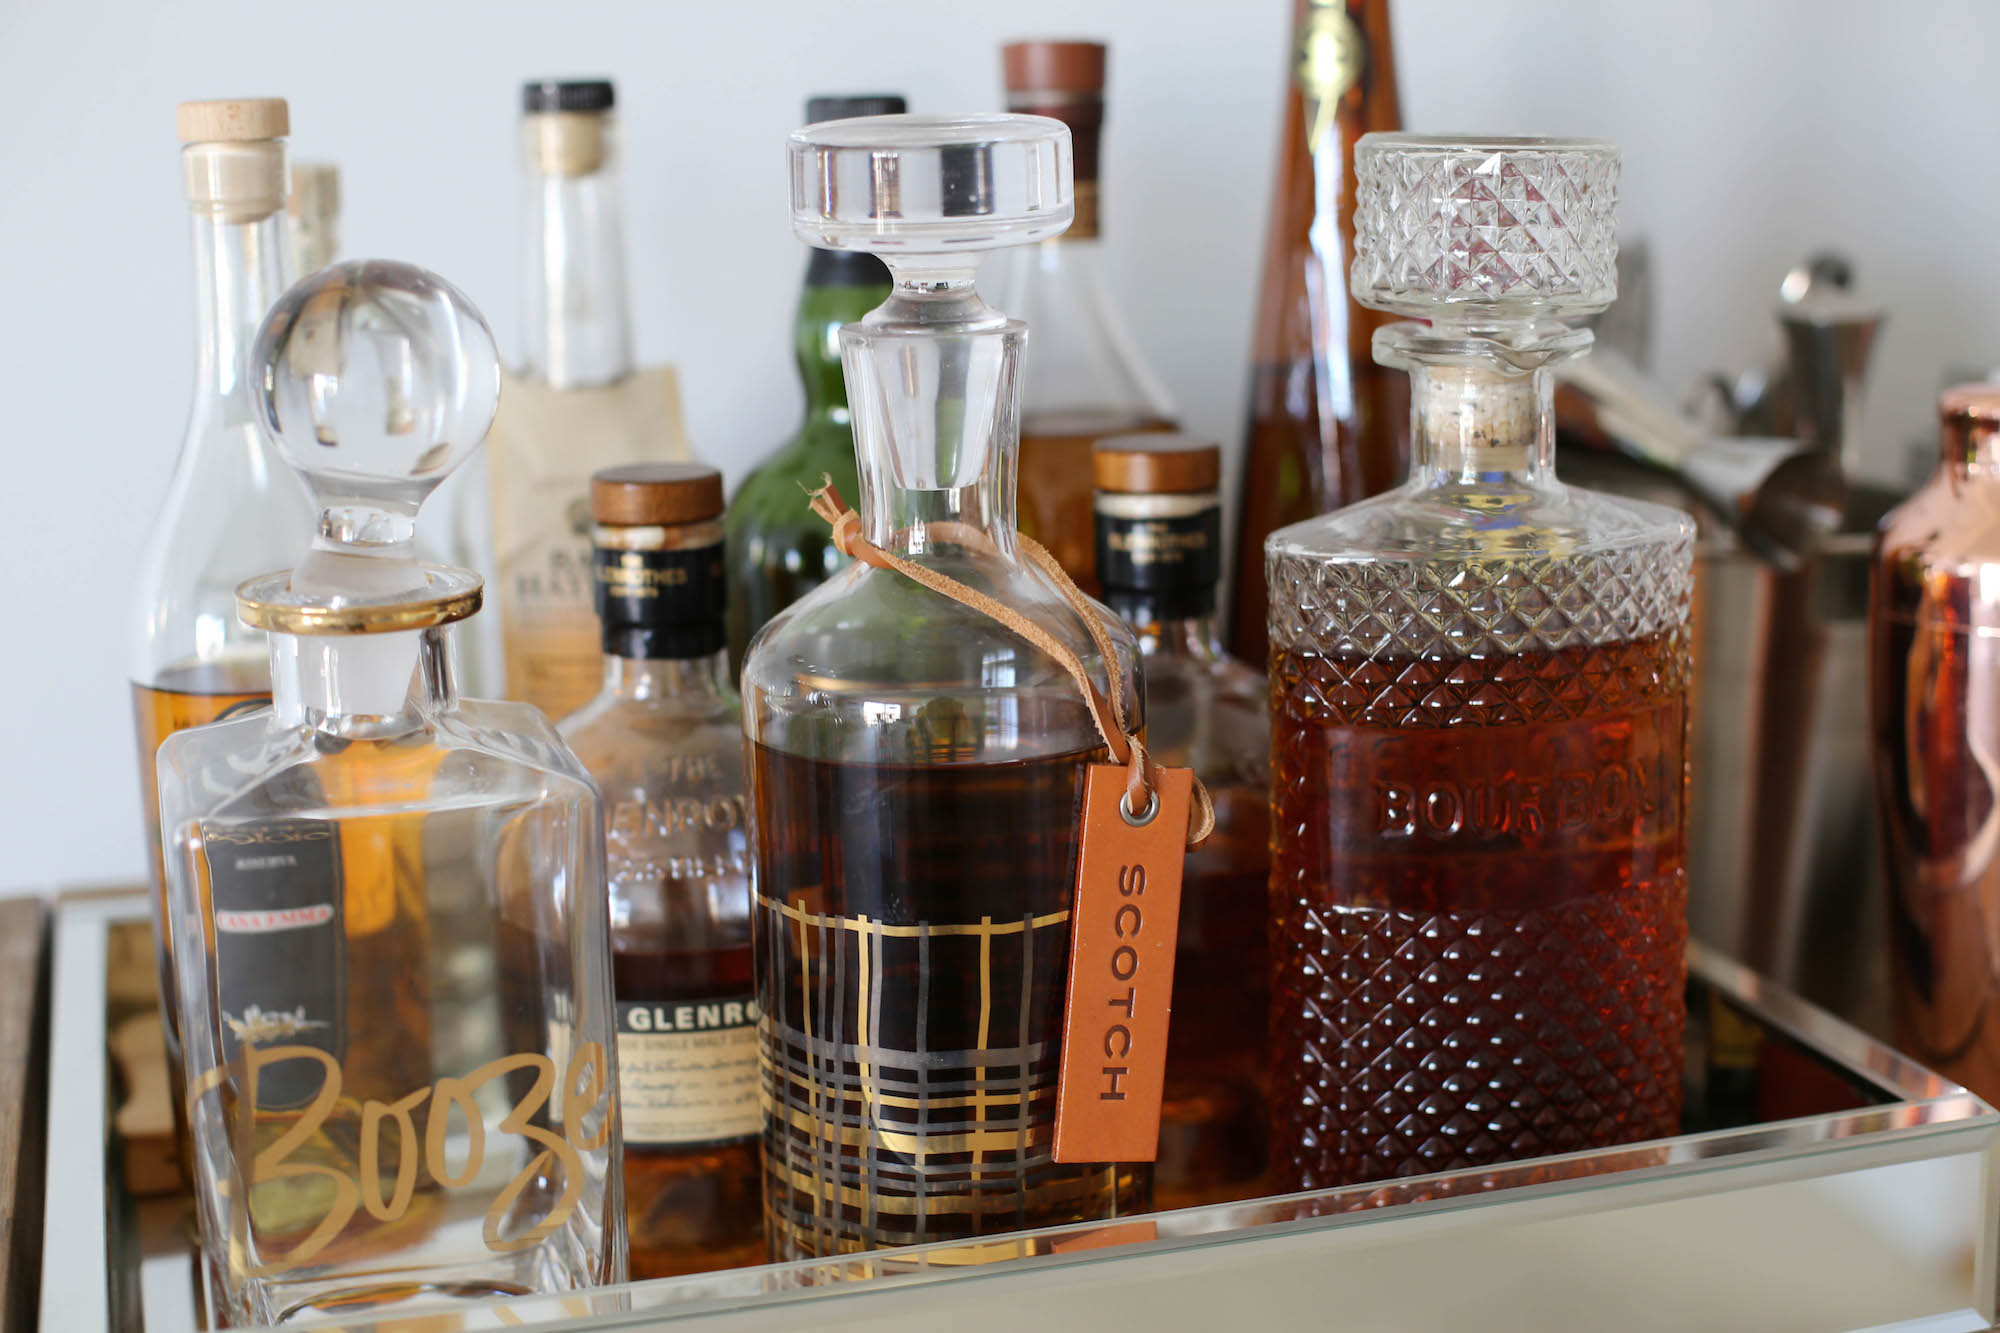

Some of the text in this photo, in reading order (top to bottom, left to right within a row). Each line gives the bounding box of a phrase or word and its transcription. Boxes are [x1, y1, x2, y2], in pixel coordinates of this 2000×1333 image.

[1376, 764, 1655, 840] BOURBON
[1100, 864, 1147, 1101] SCOTCH
[192, 1041, 609, 1278] Booze
